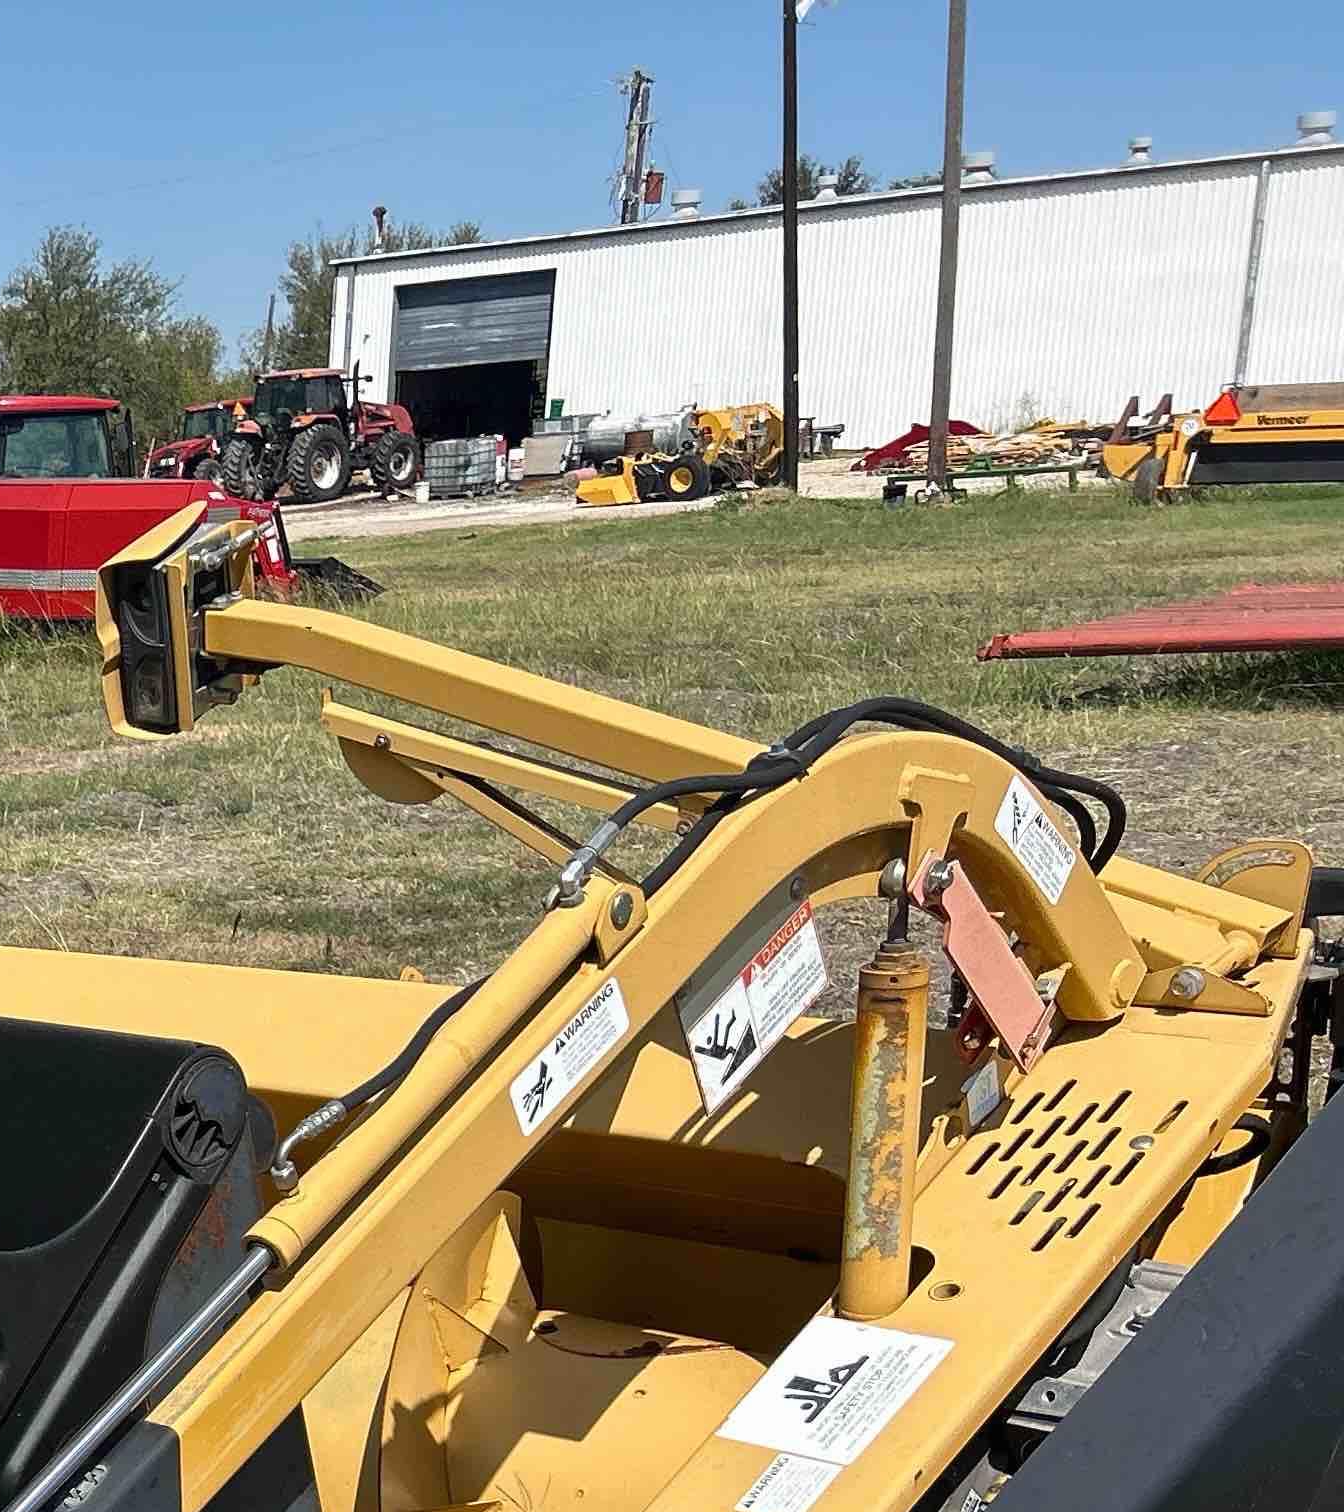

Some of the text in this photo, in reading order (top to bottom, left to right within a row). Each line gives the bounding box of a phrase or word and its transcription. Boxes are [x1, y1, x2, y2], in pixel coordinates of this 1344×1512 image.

[1256, 415, 1309, 426] Vermeer
[1040, 819, 1074, 865] WARNING
[760, 907, 810, 963] DANGER
[563, 984, 614, 1038] WARNING
[838, 1366, 885, 1420] SAFETY STOP
[749, 1456, 789, 1499] WARNING
